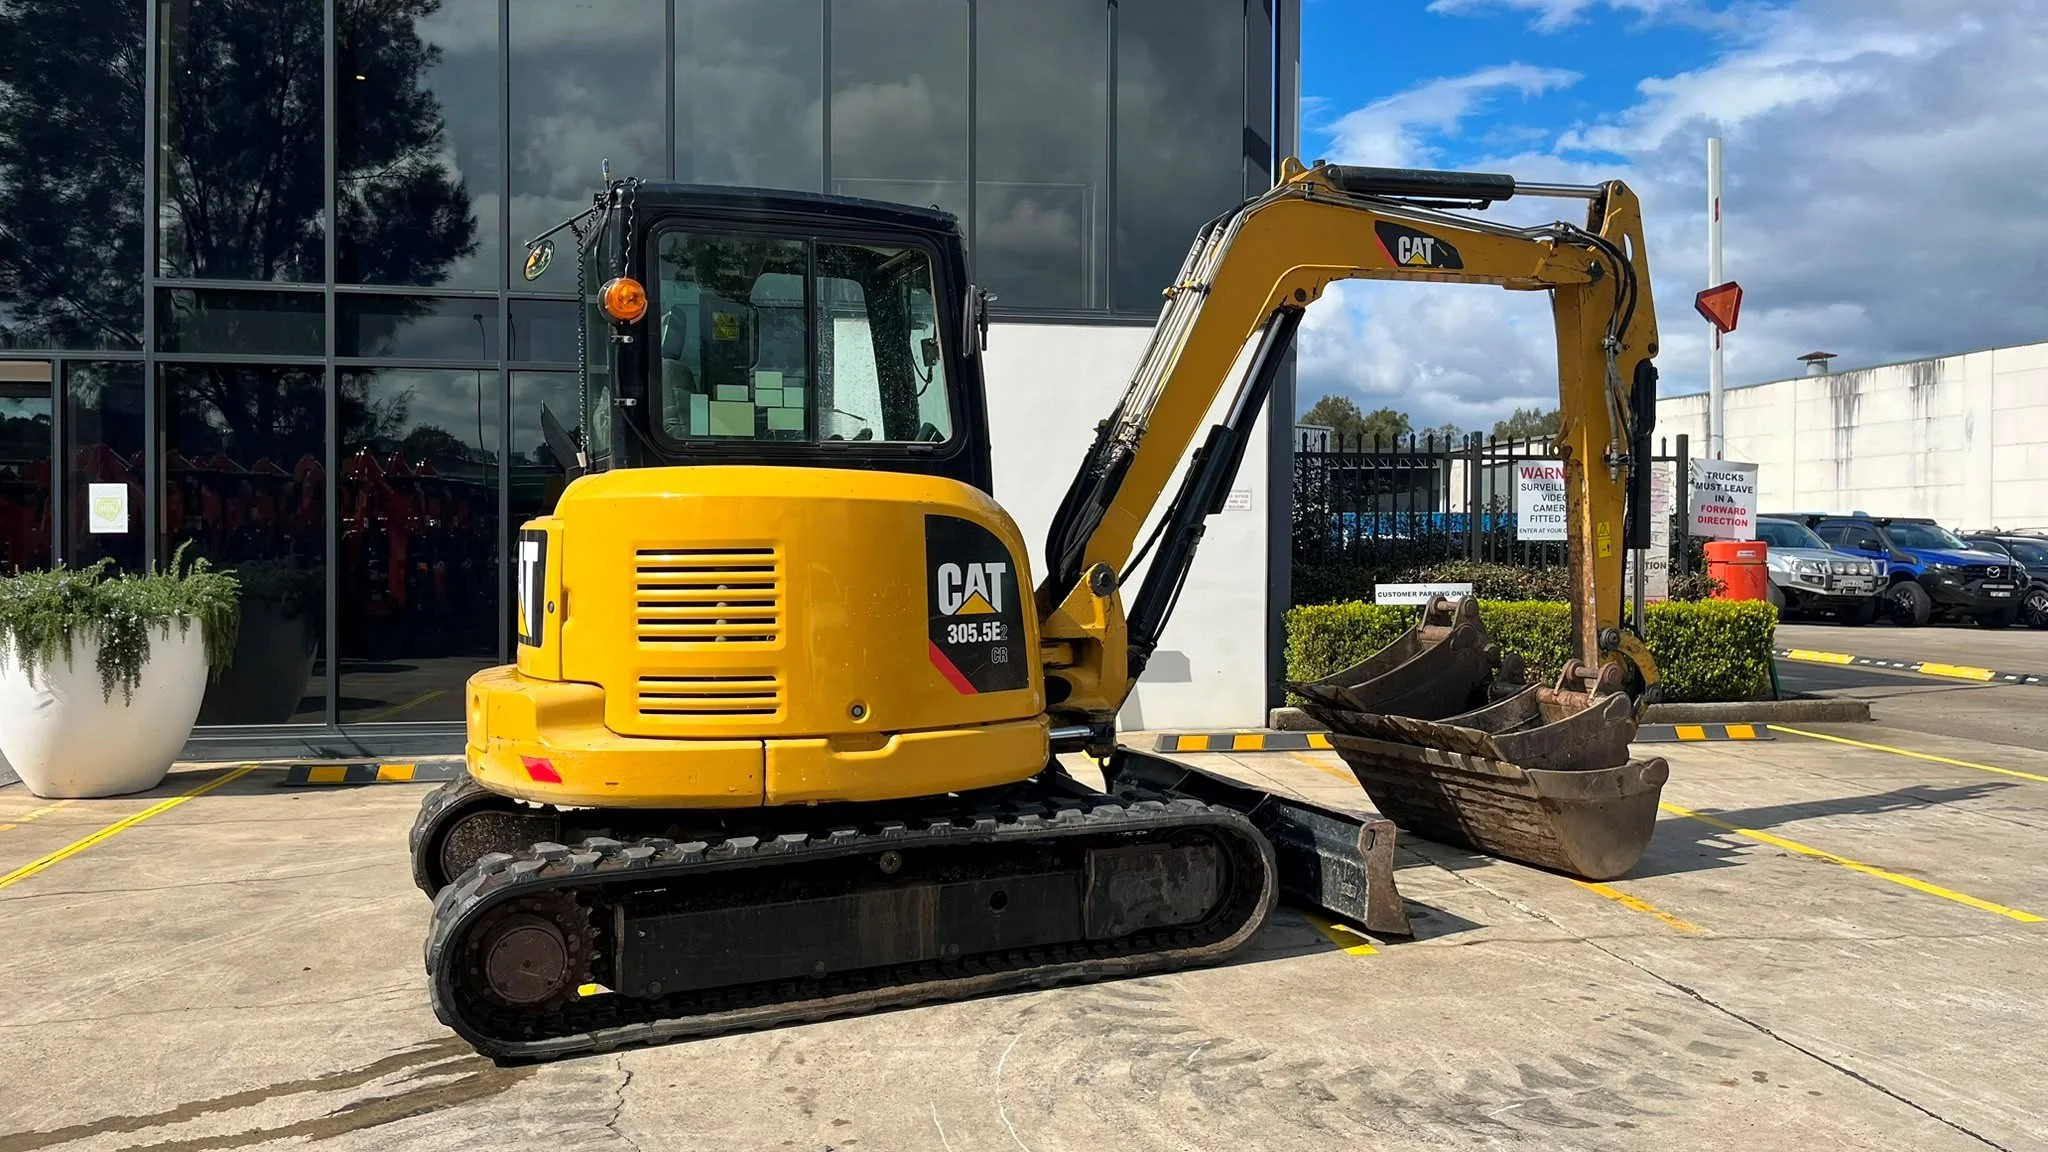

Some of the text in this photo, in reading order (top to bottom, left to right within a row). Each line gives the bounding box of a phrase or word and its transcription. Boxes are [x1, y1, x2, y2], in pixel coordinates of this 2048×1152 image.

[1398, 235, 1435, 265] CAT
[1706, 471, 1744, 481] TRUCKS
[1695, 481, 1753, 494] MUST LEAVE
[1714, 494, 1734, 503] IN A
[1700, 504, 1746, 515] FORWARD
[1697, 515, 1748, 527] DIRECTION
[937, 562, 1007, 616] CAT
[991, 646, 1008, 663] CR
